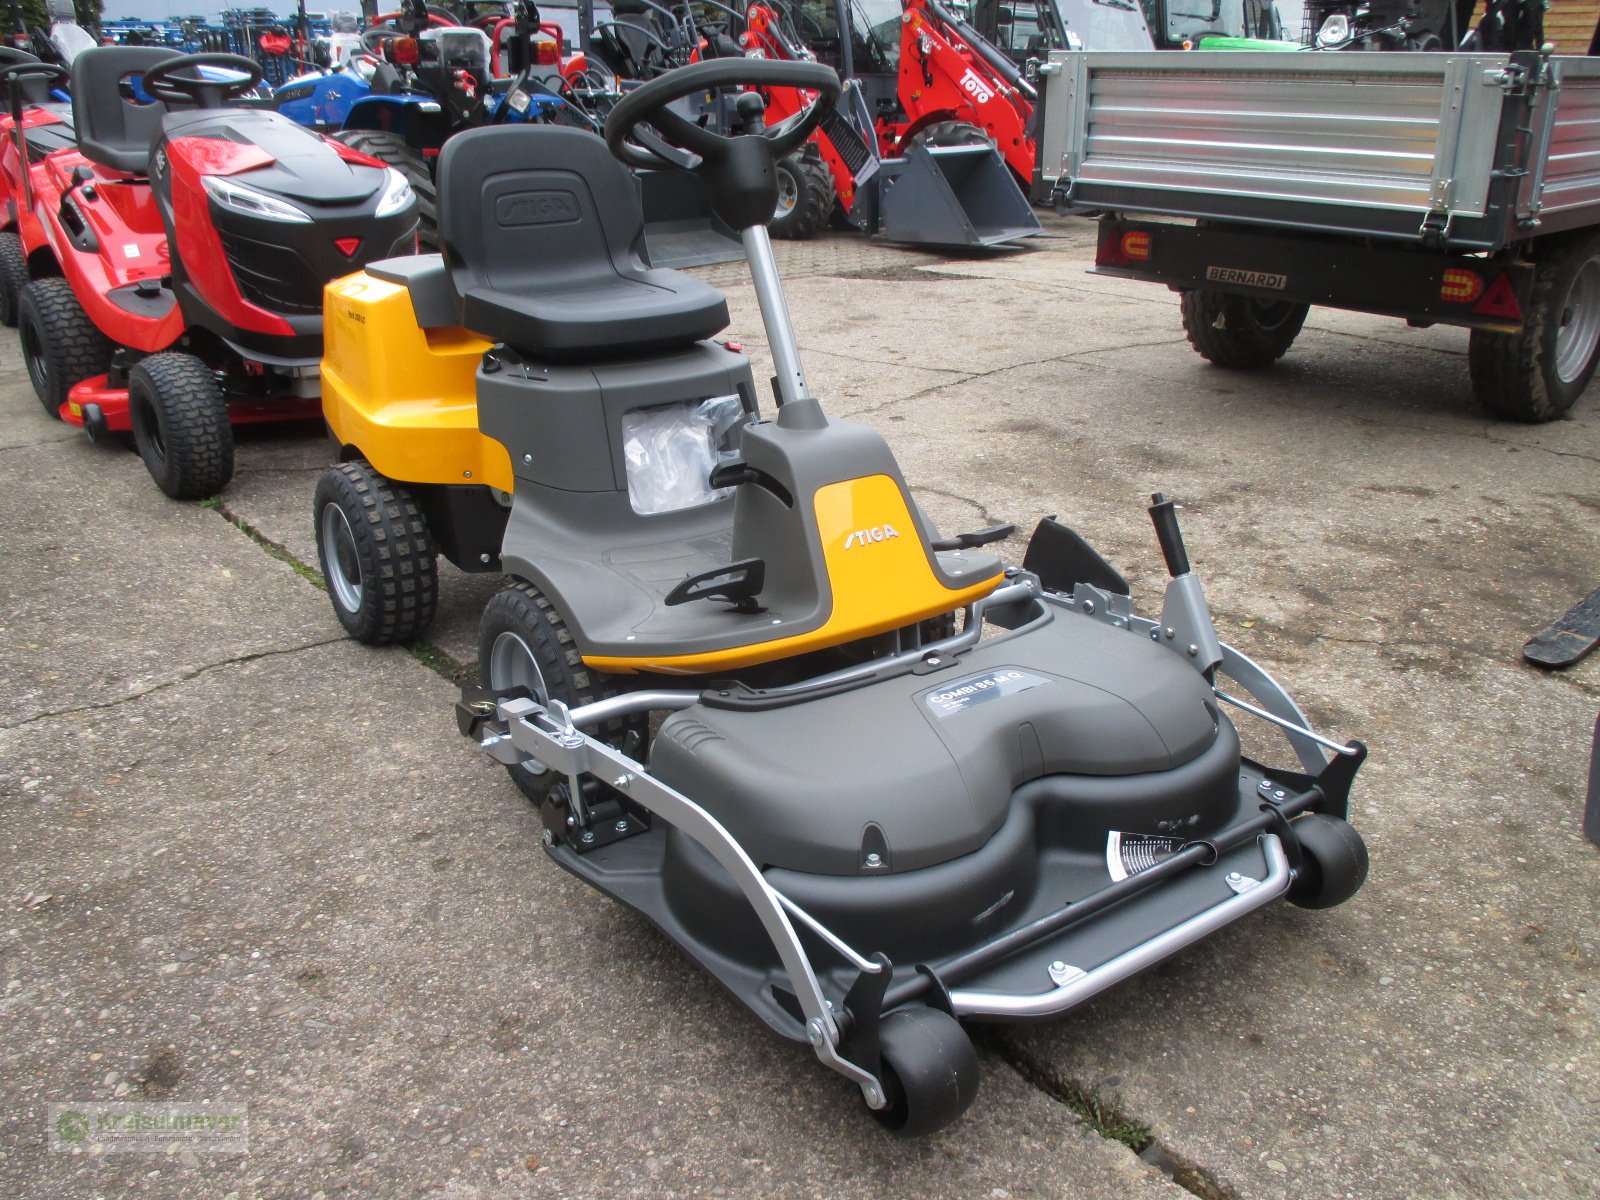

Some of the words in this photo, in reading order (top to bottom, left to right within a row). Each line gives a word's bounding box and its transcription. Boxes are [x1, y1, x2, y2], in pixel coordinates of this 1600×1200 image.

[960, 68, 995, 103] TOYO
[504, 198, 572, 220] STIGA
[1210, 268, 1284, 288] BERNARDI
[843, 524, 899, 550] STIGA
[930, 685, 978, 703] COMBI
